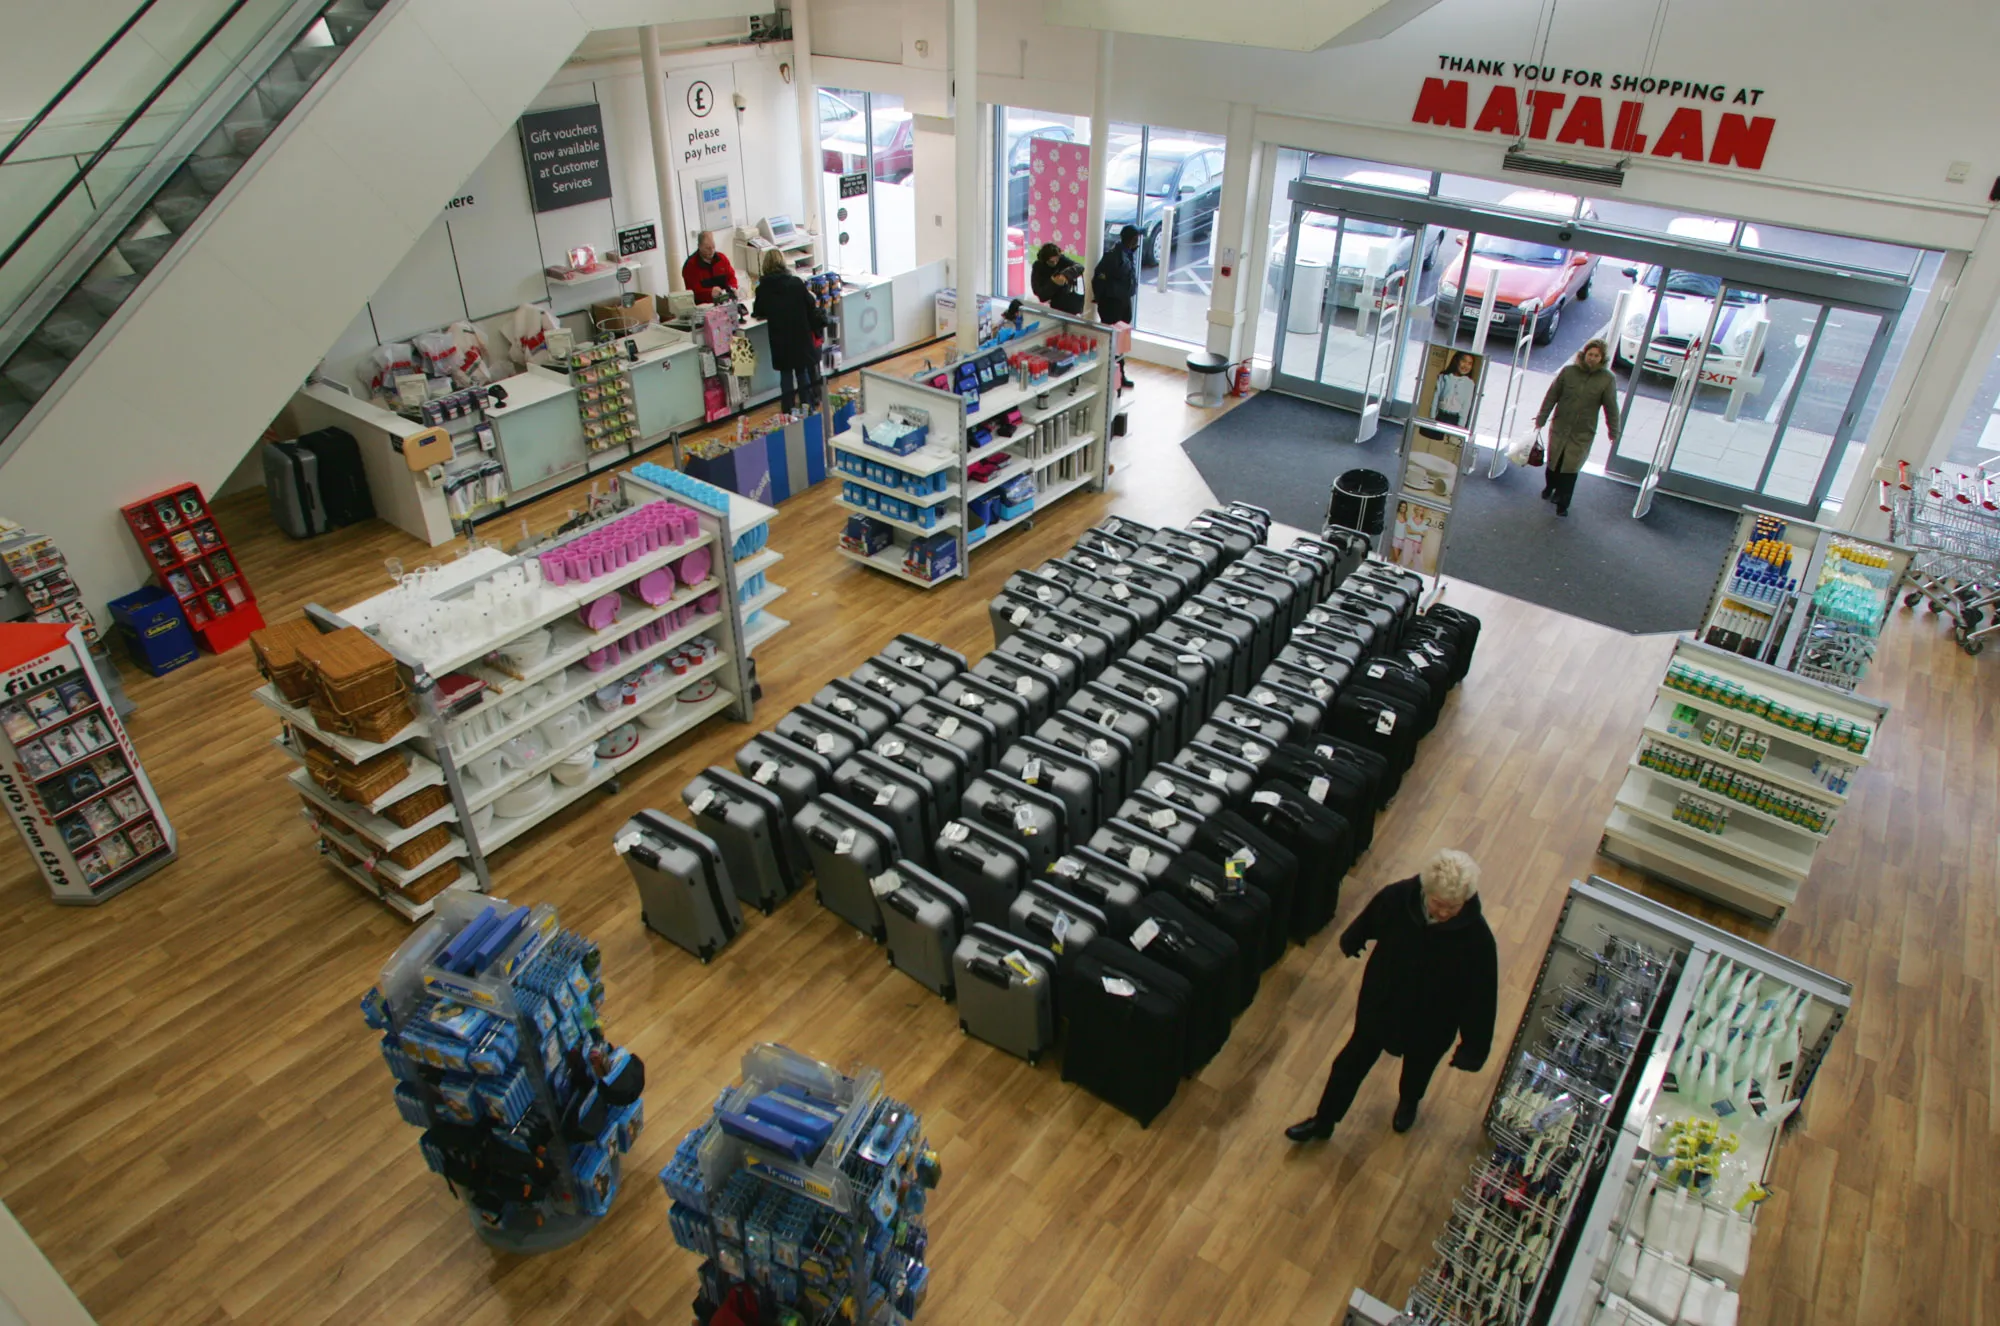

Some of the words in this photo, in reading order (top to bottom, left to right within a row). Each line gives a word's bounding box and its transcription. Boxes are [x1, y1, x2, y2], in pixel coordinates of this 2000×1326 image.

[1439, 55, 1506, 77] THANK
[1513, 63, 1555, 83] YOU
[1562, 69, 1602, 88] FOR
[1610, 74, 1725, 101] SHOPPING
[1732, 88, 1764, 106] AT
[530, 129, 551, 143] Gift
[553, 124, 598, 140] vouchers
[1411, 77, 1776, 170] MATALAN
[688, 128, 720, 145] please
[534, 149, 555, 161] now
[558, 140, 600, 157] available
[684, 147, 702, 163] pay
[705, 142, 727, 155] here
[540, 167, 550, 178] at
[552, 159, 599, 176] Customer
[552, 177, 592, 193] Services
[1699, 370, 1737, 386] EXIT
[8, 655, 51, 678] MATALAN
[4, 664, 67, 697] film
[106, 705, 140, 770] MATALAN
[12, 761, 55, 827] MATALAN
[0, 774, 29, 813] DVD's
[20, 815, 46, 848] from
[39, 848, 69, 887] £3.99
